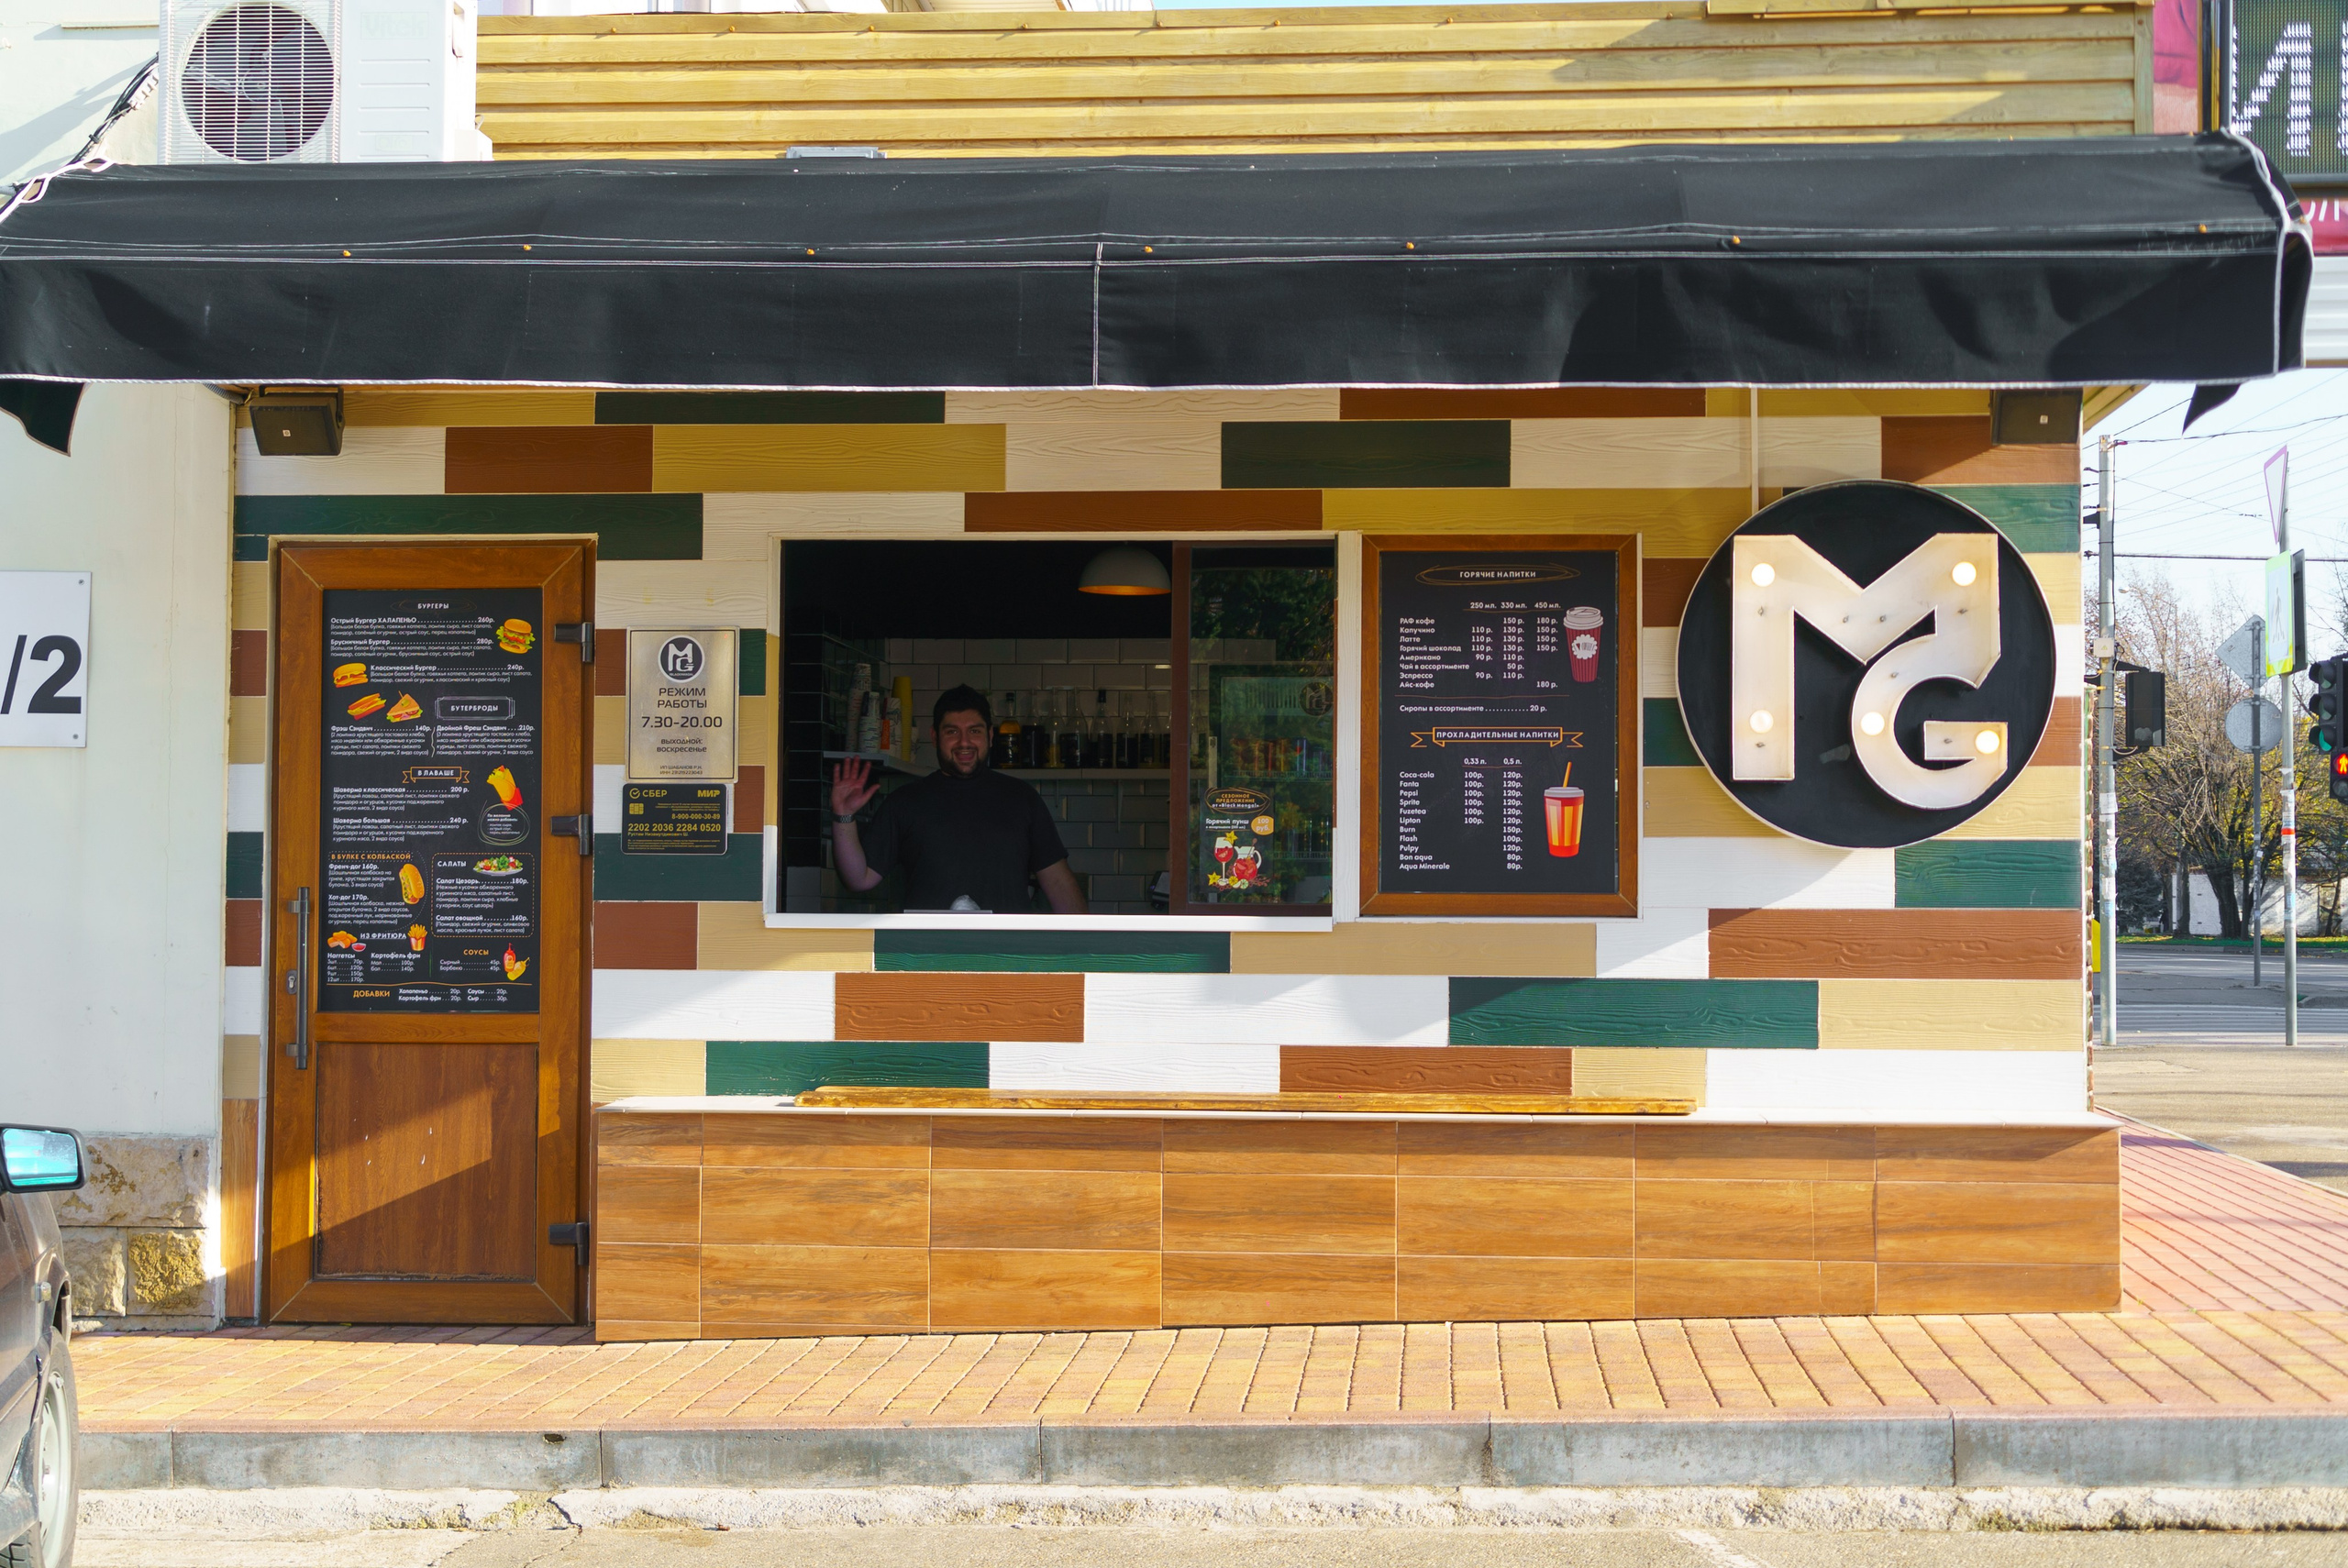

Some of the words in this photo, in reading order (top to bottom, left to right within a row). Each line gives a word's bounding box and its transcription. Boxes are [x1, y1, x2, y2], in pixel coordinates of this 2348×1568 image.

[1733, 534, 2008, 810] MG
[659, 688, 705, 696] РЕЖИМ
[658, 700, 706, 708] РАБОТЫ
[642, 716, 722, 727] 7.30-20.00
[1400, 790, 1418, 798] Pepsi
[1400, 799, 1420, 807] Sprite
[628, 823, 649, 832] 2202
[652, 823, 673, 832] 2036
[677, 823, 697, 832] 2284
[701, 823, 721, 832] 0520
[1400, 845, 1419, 853] Pulpy
